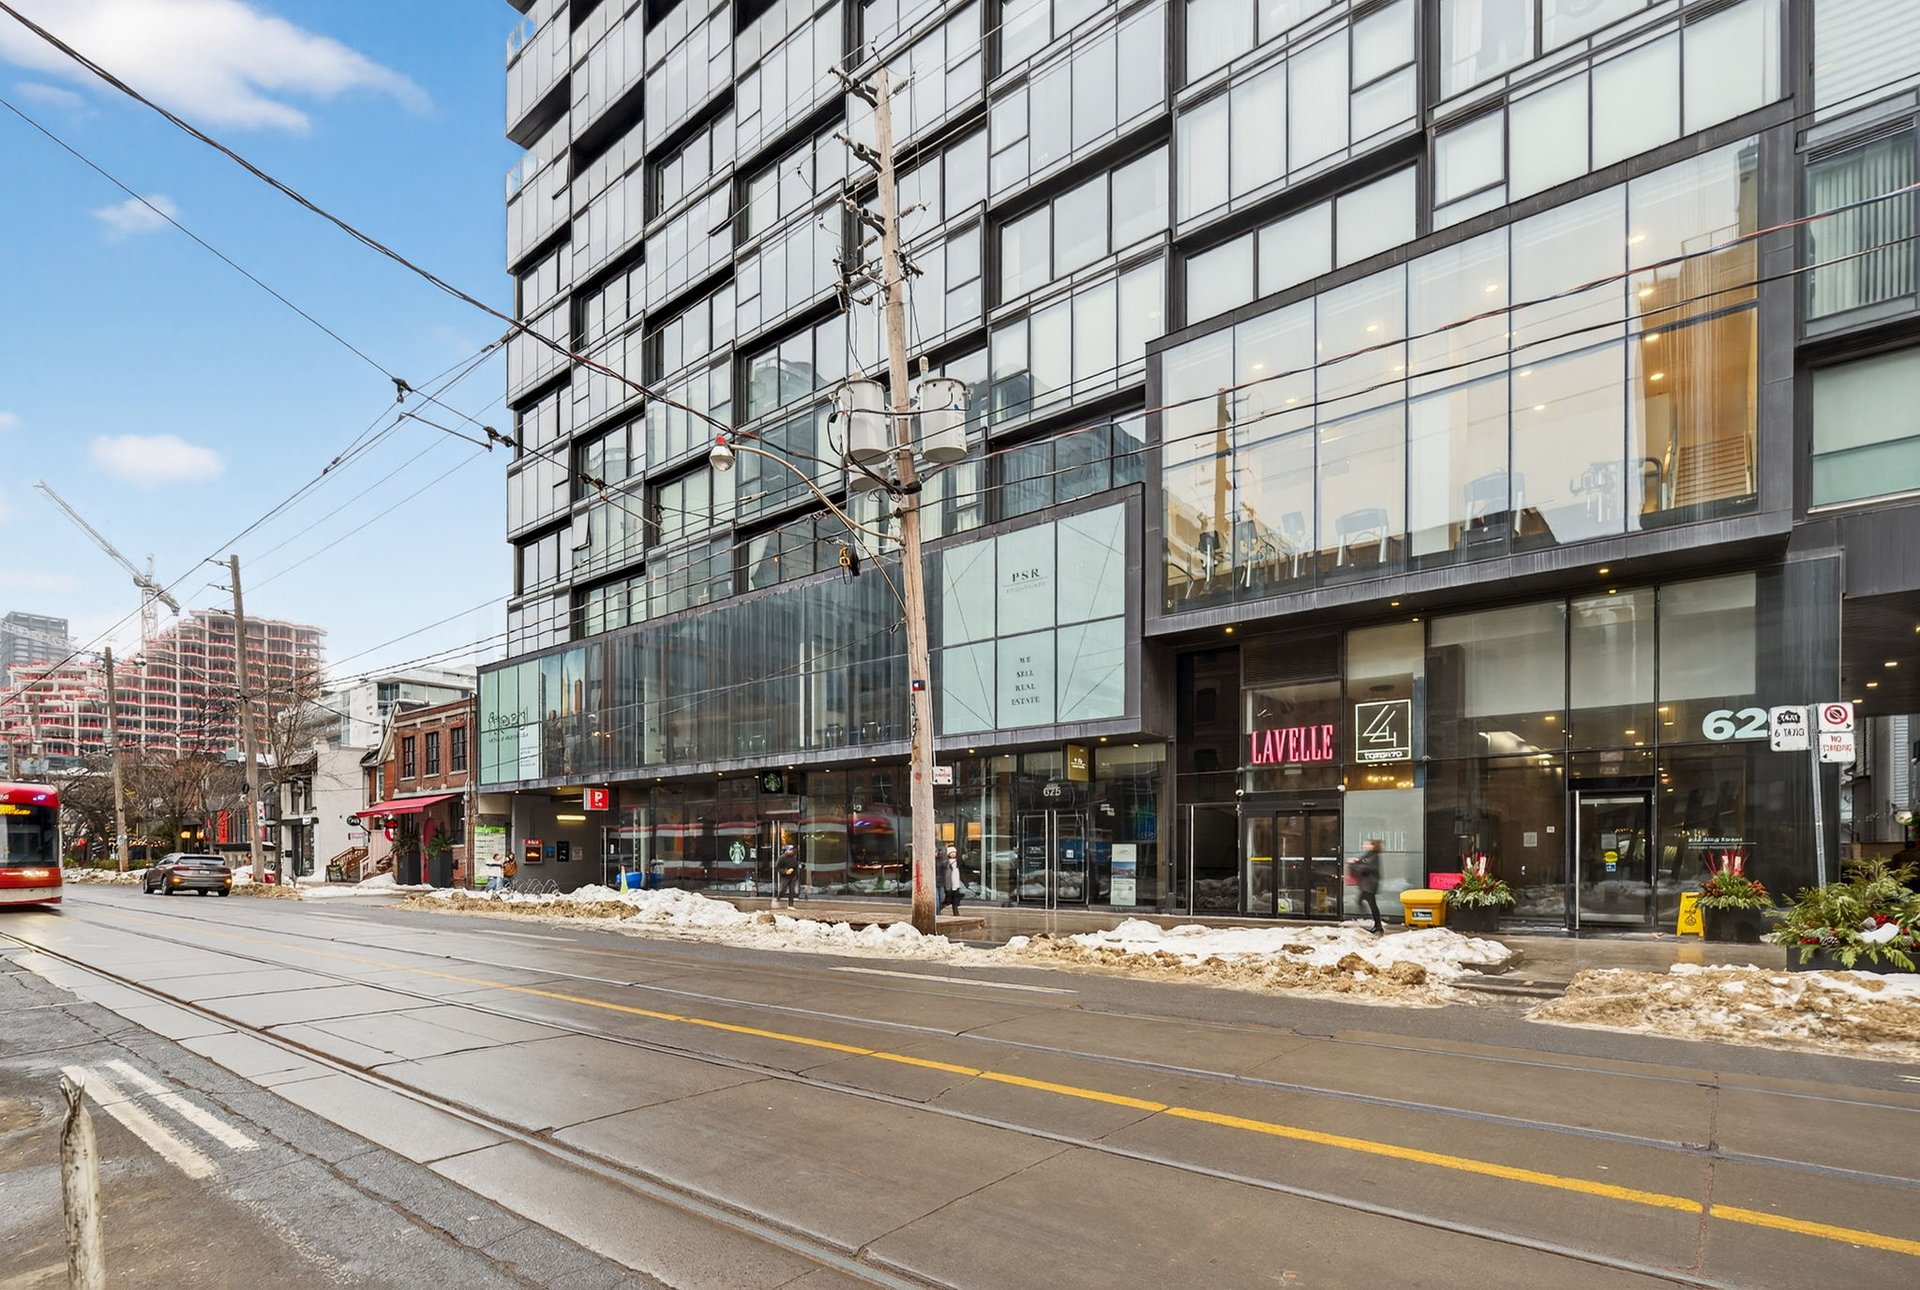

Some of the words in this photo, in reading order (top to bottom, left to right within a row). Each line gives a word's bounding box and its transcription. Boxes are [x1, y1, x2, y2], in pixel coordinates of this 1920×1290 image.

[1012, 568, 1040, 582] PSR
[1702, 707, 1770, 741] 62
[1251, 724, 1333, 764] LAVELLE
